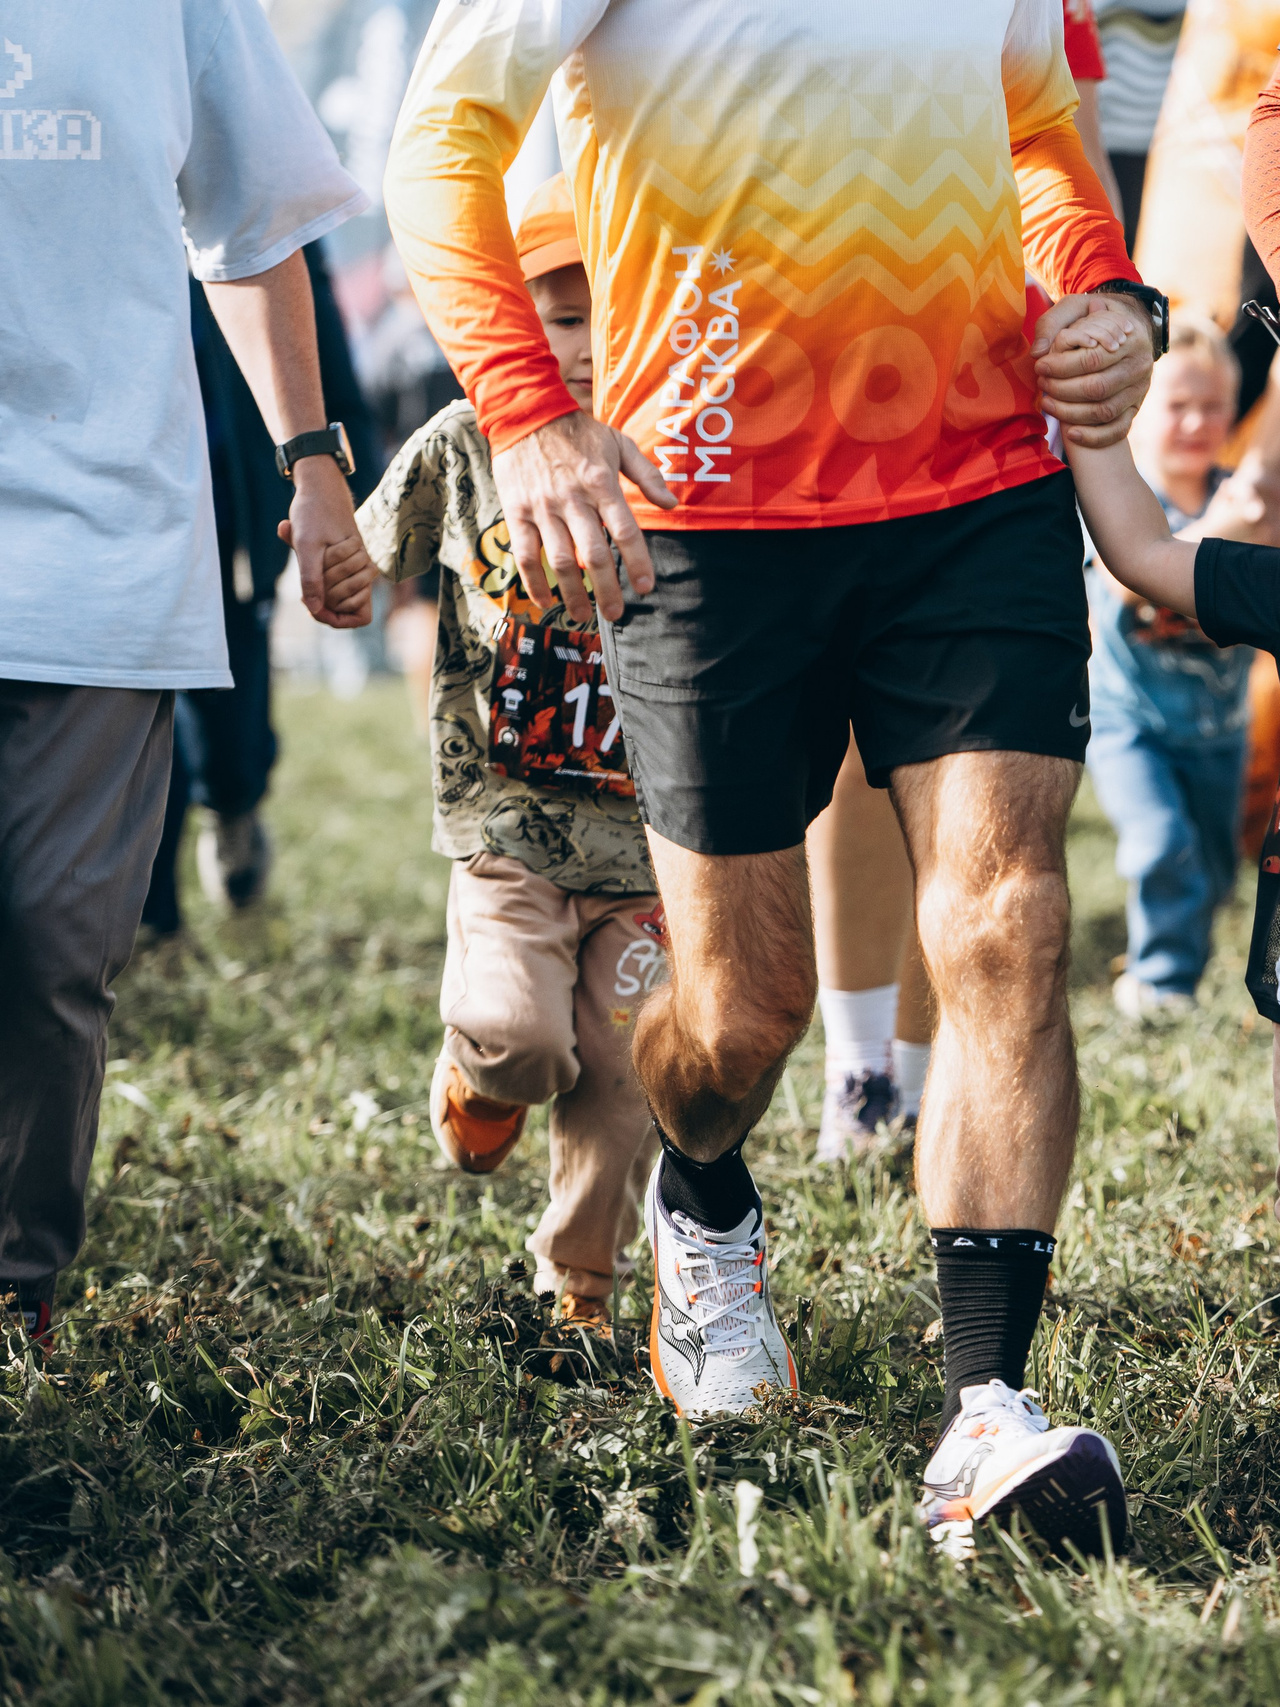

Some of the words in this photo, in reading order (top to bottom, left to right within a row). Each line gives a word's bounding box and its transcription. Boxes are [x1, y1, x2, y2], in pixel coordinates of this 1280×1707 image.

[0, 110, 101, 159] КА
[654, 245, 704, 483] МАРАФОН
[694, 279, 743, 483] МОСКВА
